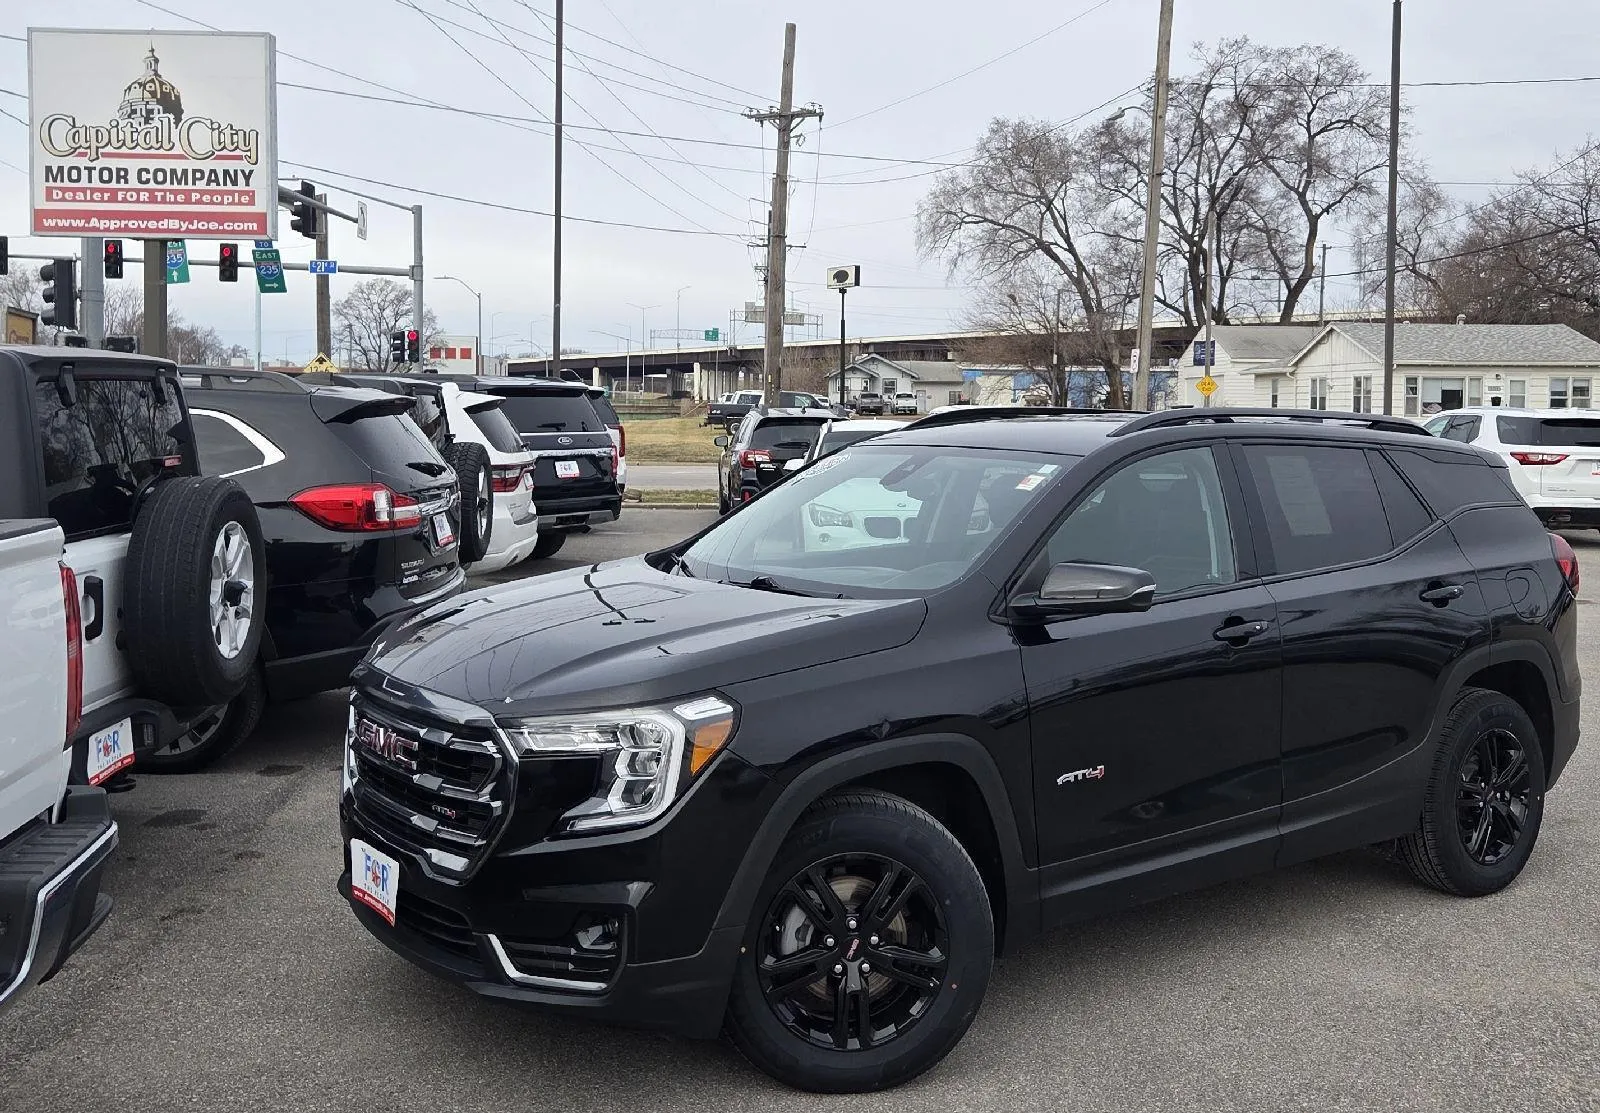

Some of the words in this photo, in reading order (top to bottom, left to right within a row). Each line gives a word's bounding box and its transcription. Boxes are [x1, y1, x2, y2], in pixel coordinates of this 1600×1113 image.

[40, 113, 175, 162] Capital
[179, 116, 259, 165] City
[44, 165, 130, 185] MOTOR
[136, 168, 255, 187] COMPANY
[52, 189, 111, 201] Dealer
[117, 191, 150, 202] FOR
[155, 191, 185, 203] The
[42, 216, 258, 231] www.ApprovedByJoe.com
[167, 253, 183, 264] 235
[255, 251, 276, 259] EAST
[261, 265, 279, 274] 235
[358, 718, 419, 771] GMC
[1056, 764, 1105, 785] AT4
[365, 853, 389, 896] FOR
